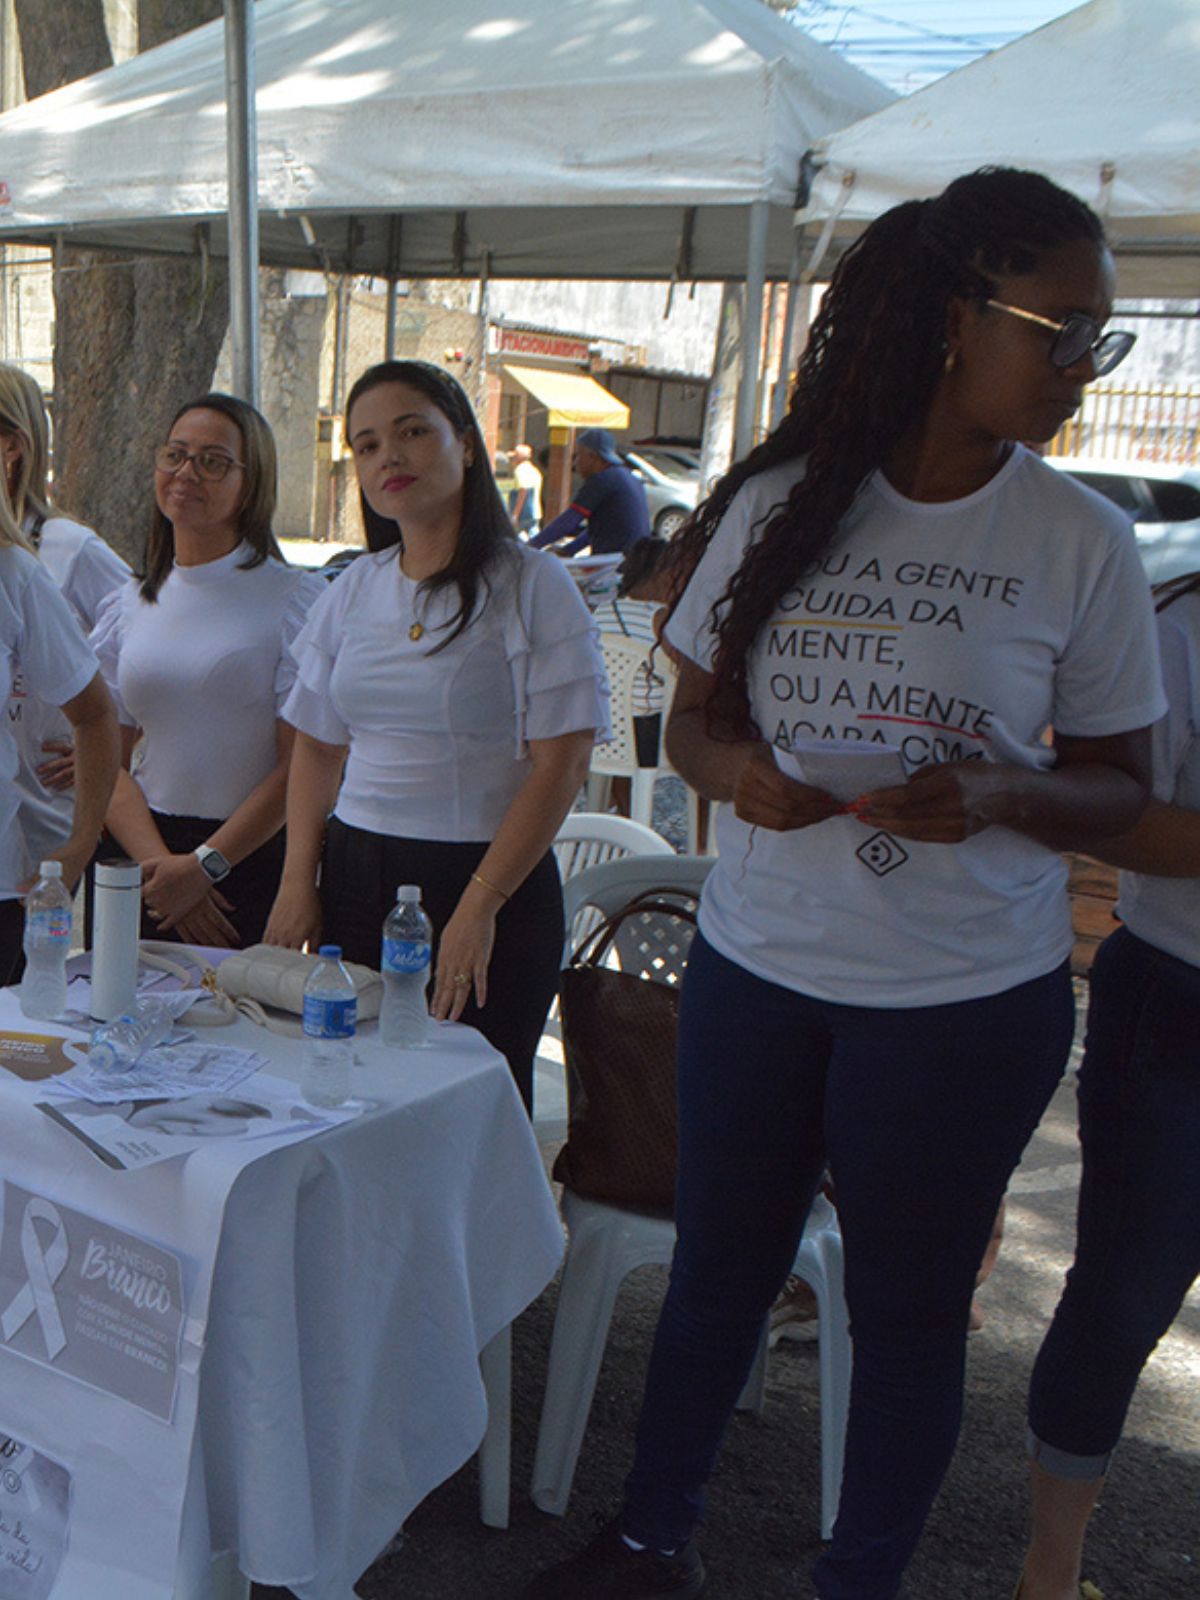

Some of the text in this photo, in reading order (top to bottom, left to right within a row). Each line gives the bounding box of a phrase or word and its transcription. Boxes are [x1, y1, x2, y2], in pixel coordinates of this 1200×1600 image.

[855, 557, 881, 581] A
[895, 562, 1024, 607] GENTE
[777, 587, 964, 632] CUIDA DA
[767, 629, 905, 672] MENTE,
[769, 674, 995, 732] OU A MENTE
[80, 1239, 171, 1314] Branco
